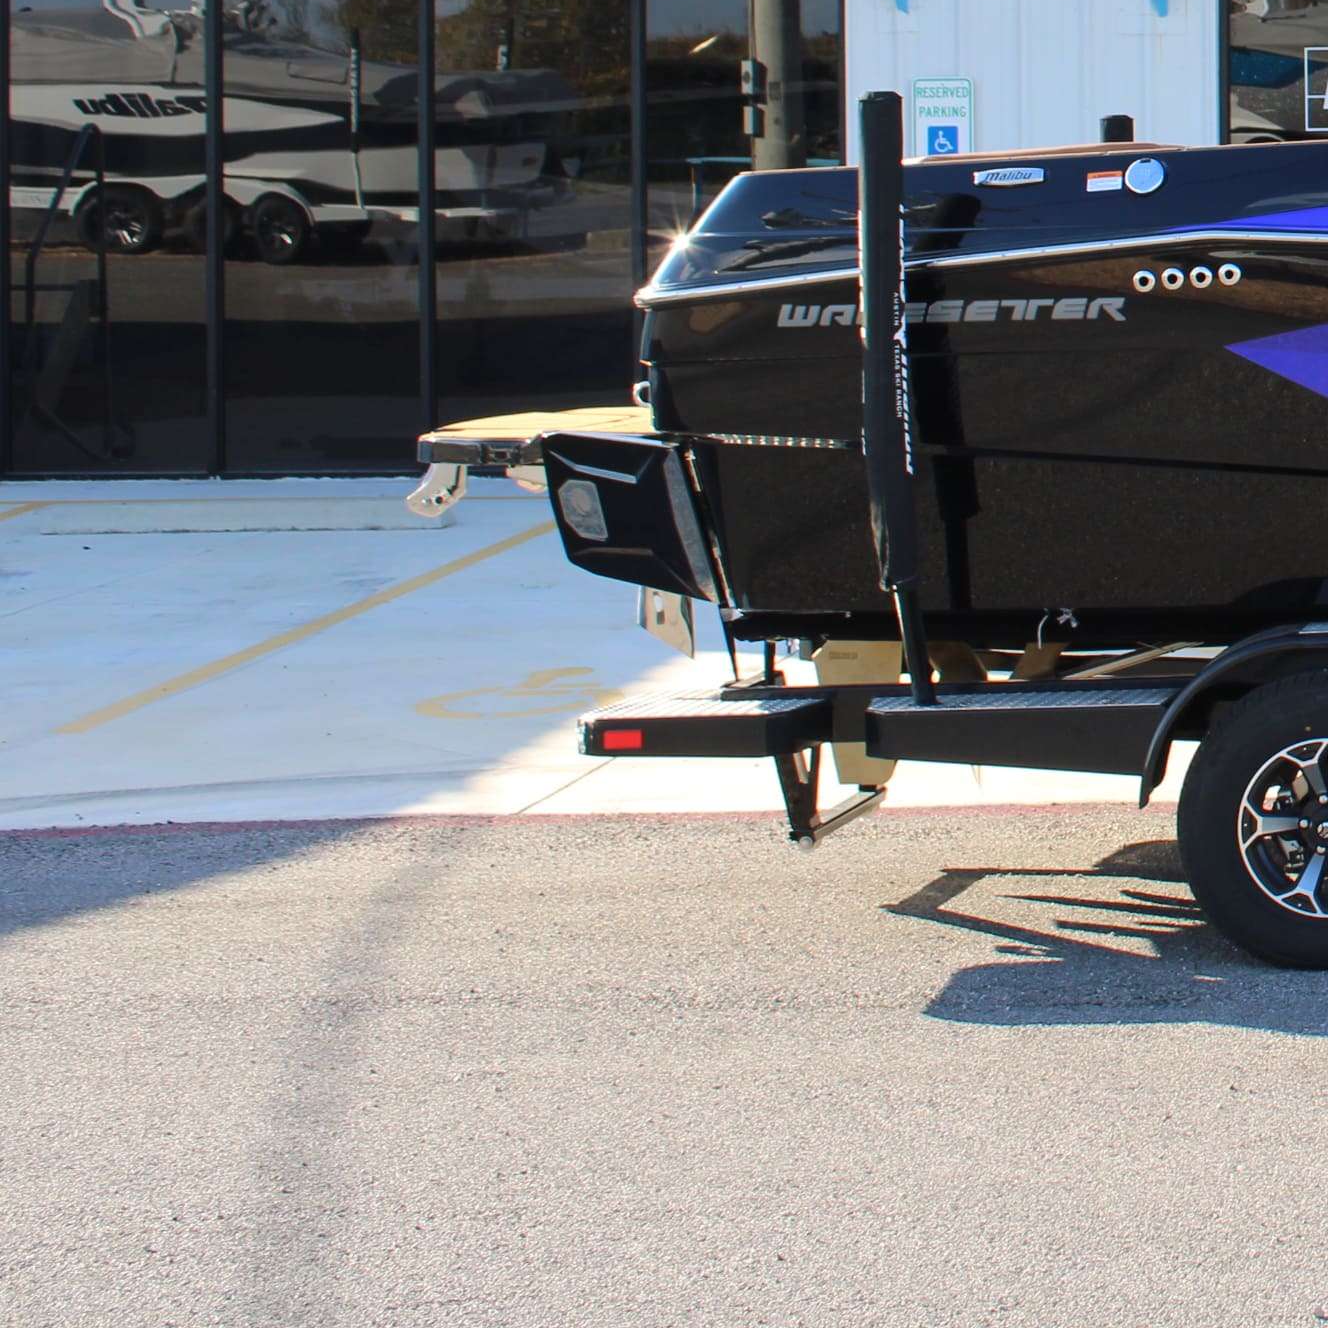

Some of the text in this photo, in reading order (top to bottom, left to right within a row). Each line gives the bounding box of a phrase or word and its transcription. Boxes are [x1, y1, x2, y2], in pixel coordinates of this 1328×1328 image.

[914, 85, 969, 99] RESERVED
[918, 106, 967, 118] PARKING
[983, 169, 1033, 182] Malibu
[777, 296, 1127, 328] WAESETTER
